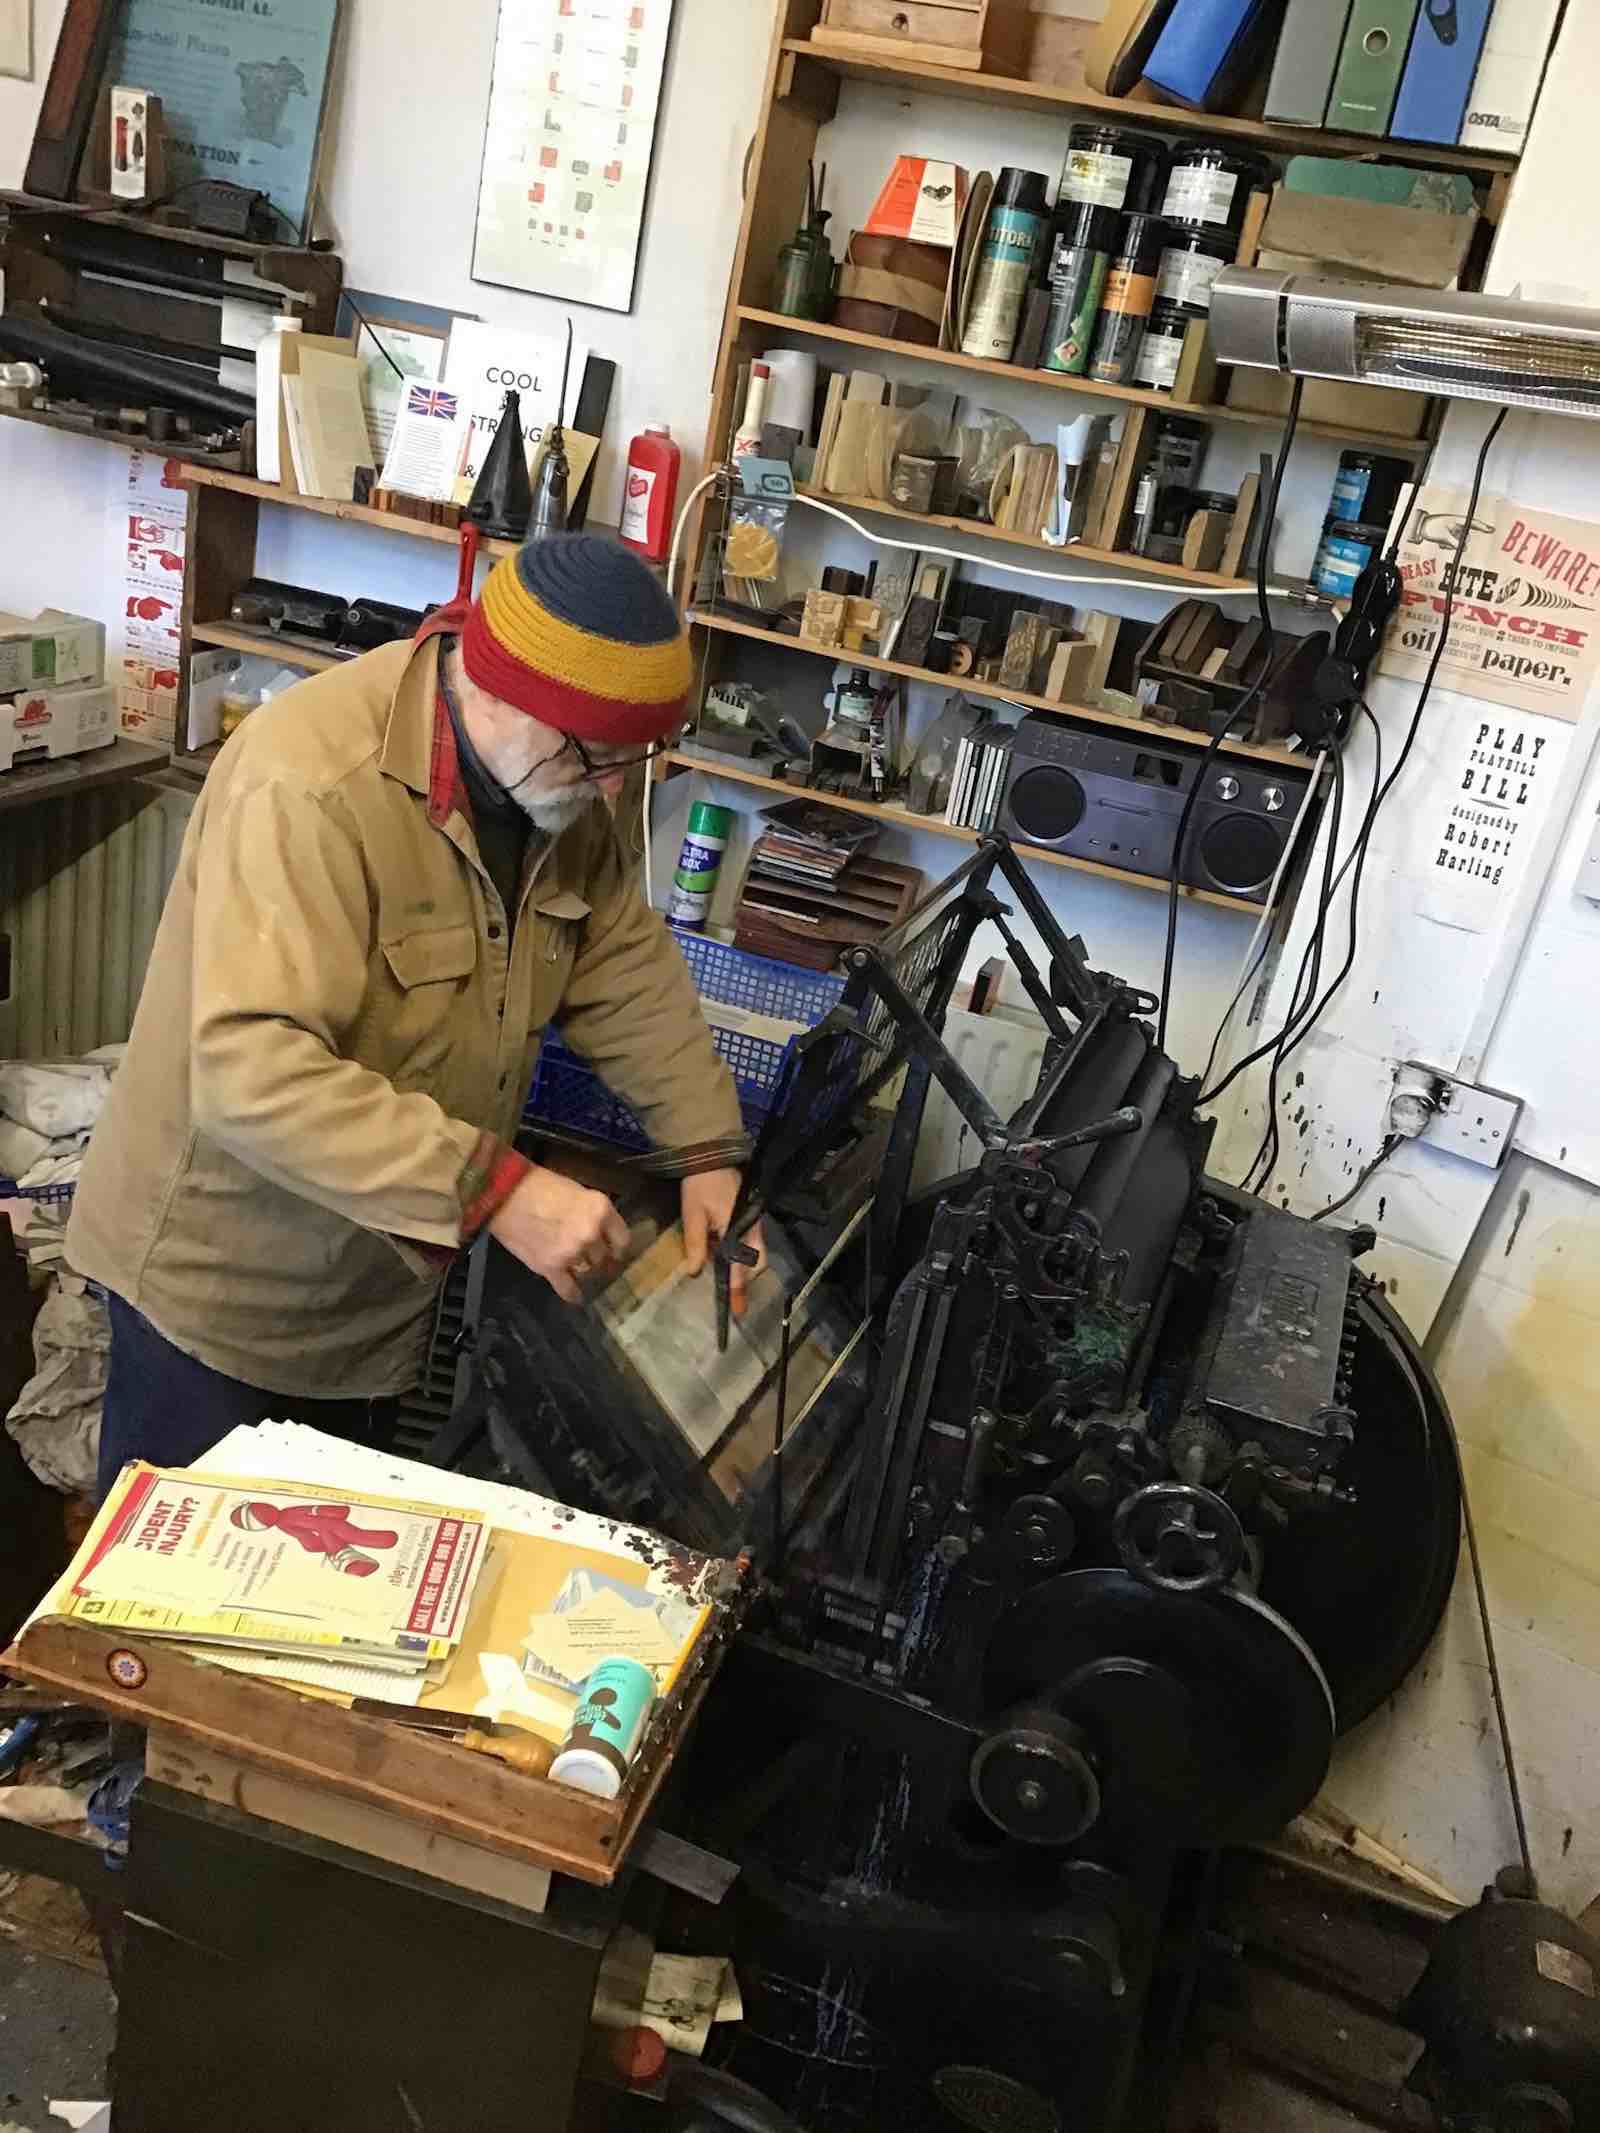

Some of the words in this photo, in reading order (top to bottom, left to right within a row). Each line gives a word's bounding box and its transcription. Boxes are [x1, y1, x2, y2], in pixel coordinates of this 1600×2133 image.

[486, 366, 542, 392] COOL
[1438, 561, 1499, 602] BITE
[1400, 589, 1589, 648] PUNCH
[1401, 627, 1438, 652] oil
[1480, 647, 1572, 686] paper.
[1476, 723, 1546, 759] PLAY
[1470, 749, 1536, 777] PLAYBILL
[1461, 768, 1528, 805] BILL
[1451, 805, 1502, 829] designed
[1504, 820, 1518, 835] by
[1444, 823, 1511, 857] Robert
[1436, 848, 1504, 885] Harling
[156, 1497, 201, 1556] INJURY?
[420, 1584, 440, 1607] FREE
[411, 1608, 433, 1630] CALL
